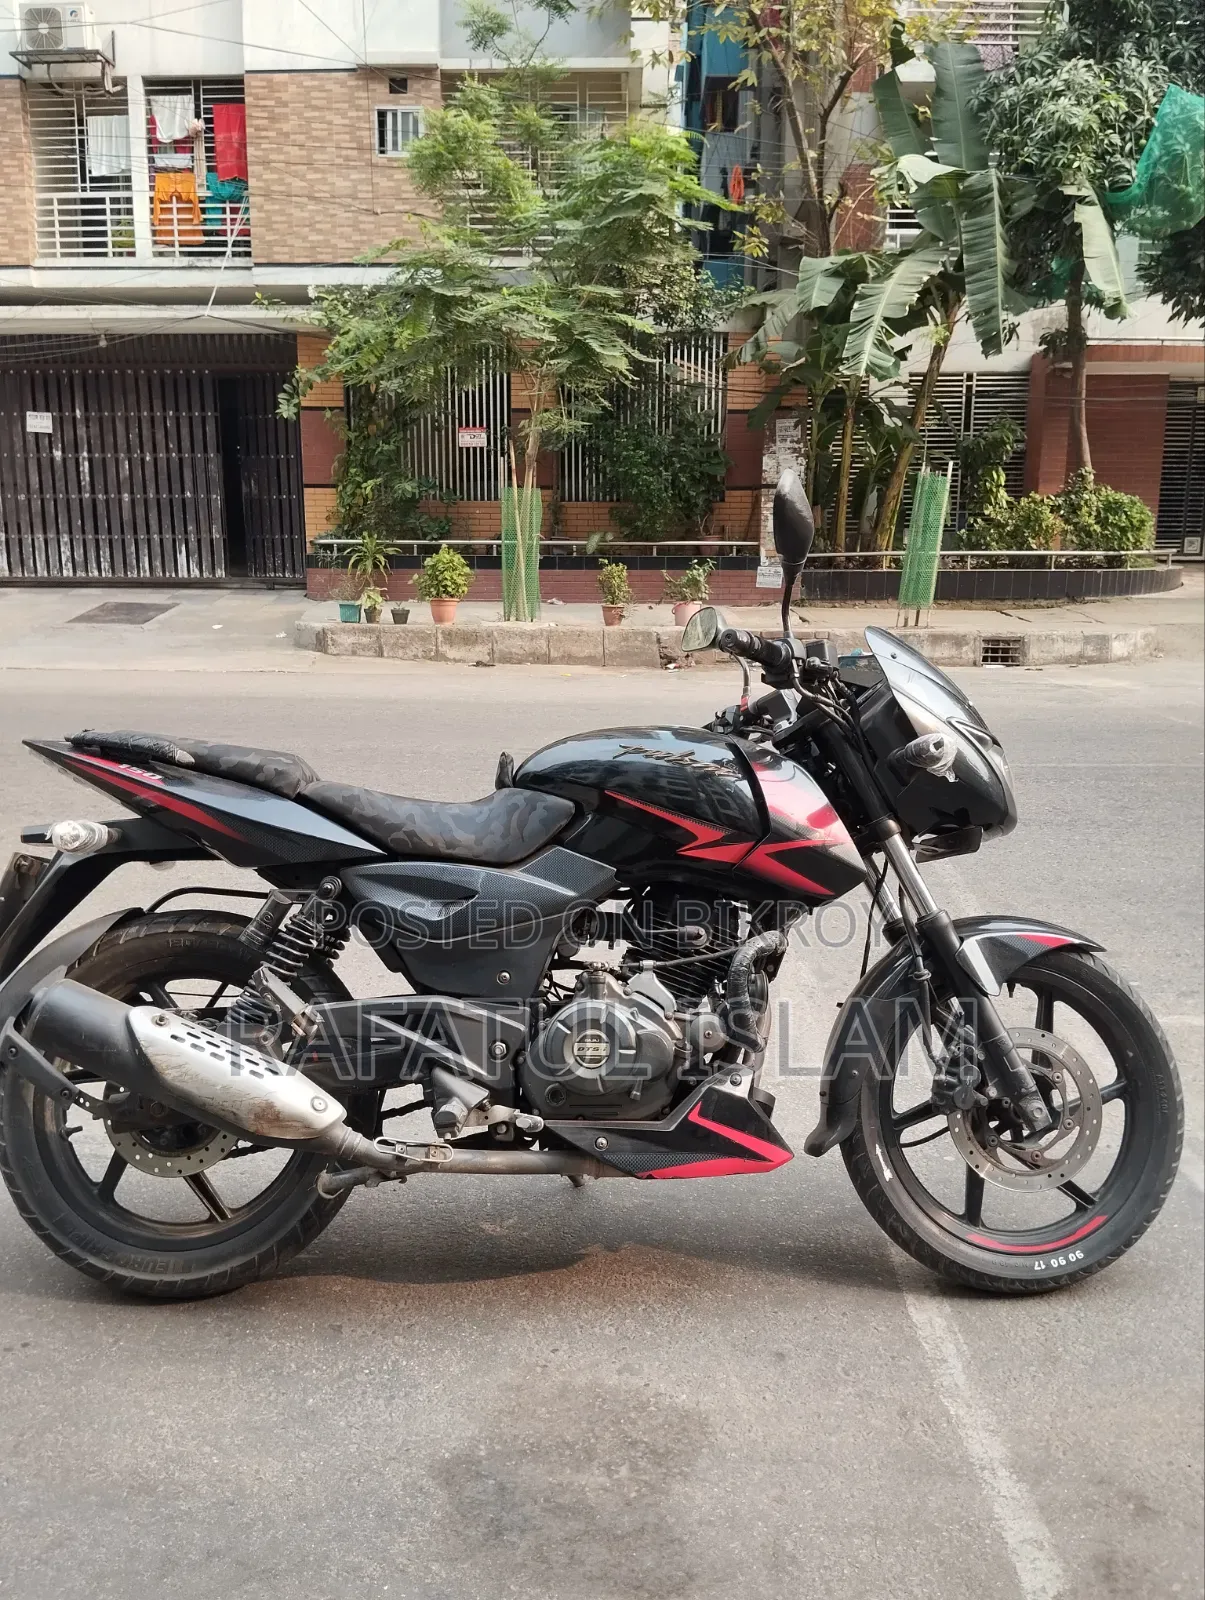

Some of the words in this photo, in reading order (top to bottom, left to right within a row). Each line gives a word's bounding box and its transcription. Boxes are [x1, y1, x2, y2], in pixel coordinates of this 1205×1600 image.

[119, 763, 163, 780] 150
[1050, 1256, 1067, 1268] 90
[1068, 1250, 1084, 1262] 90
[1034, 1260, 1046, 1270] 17
